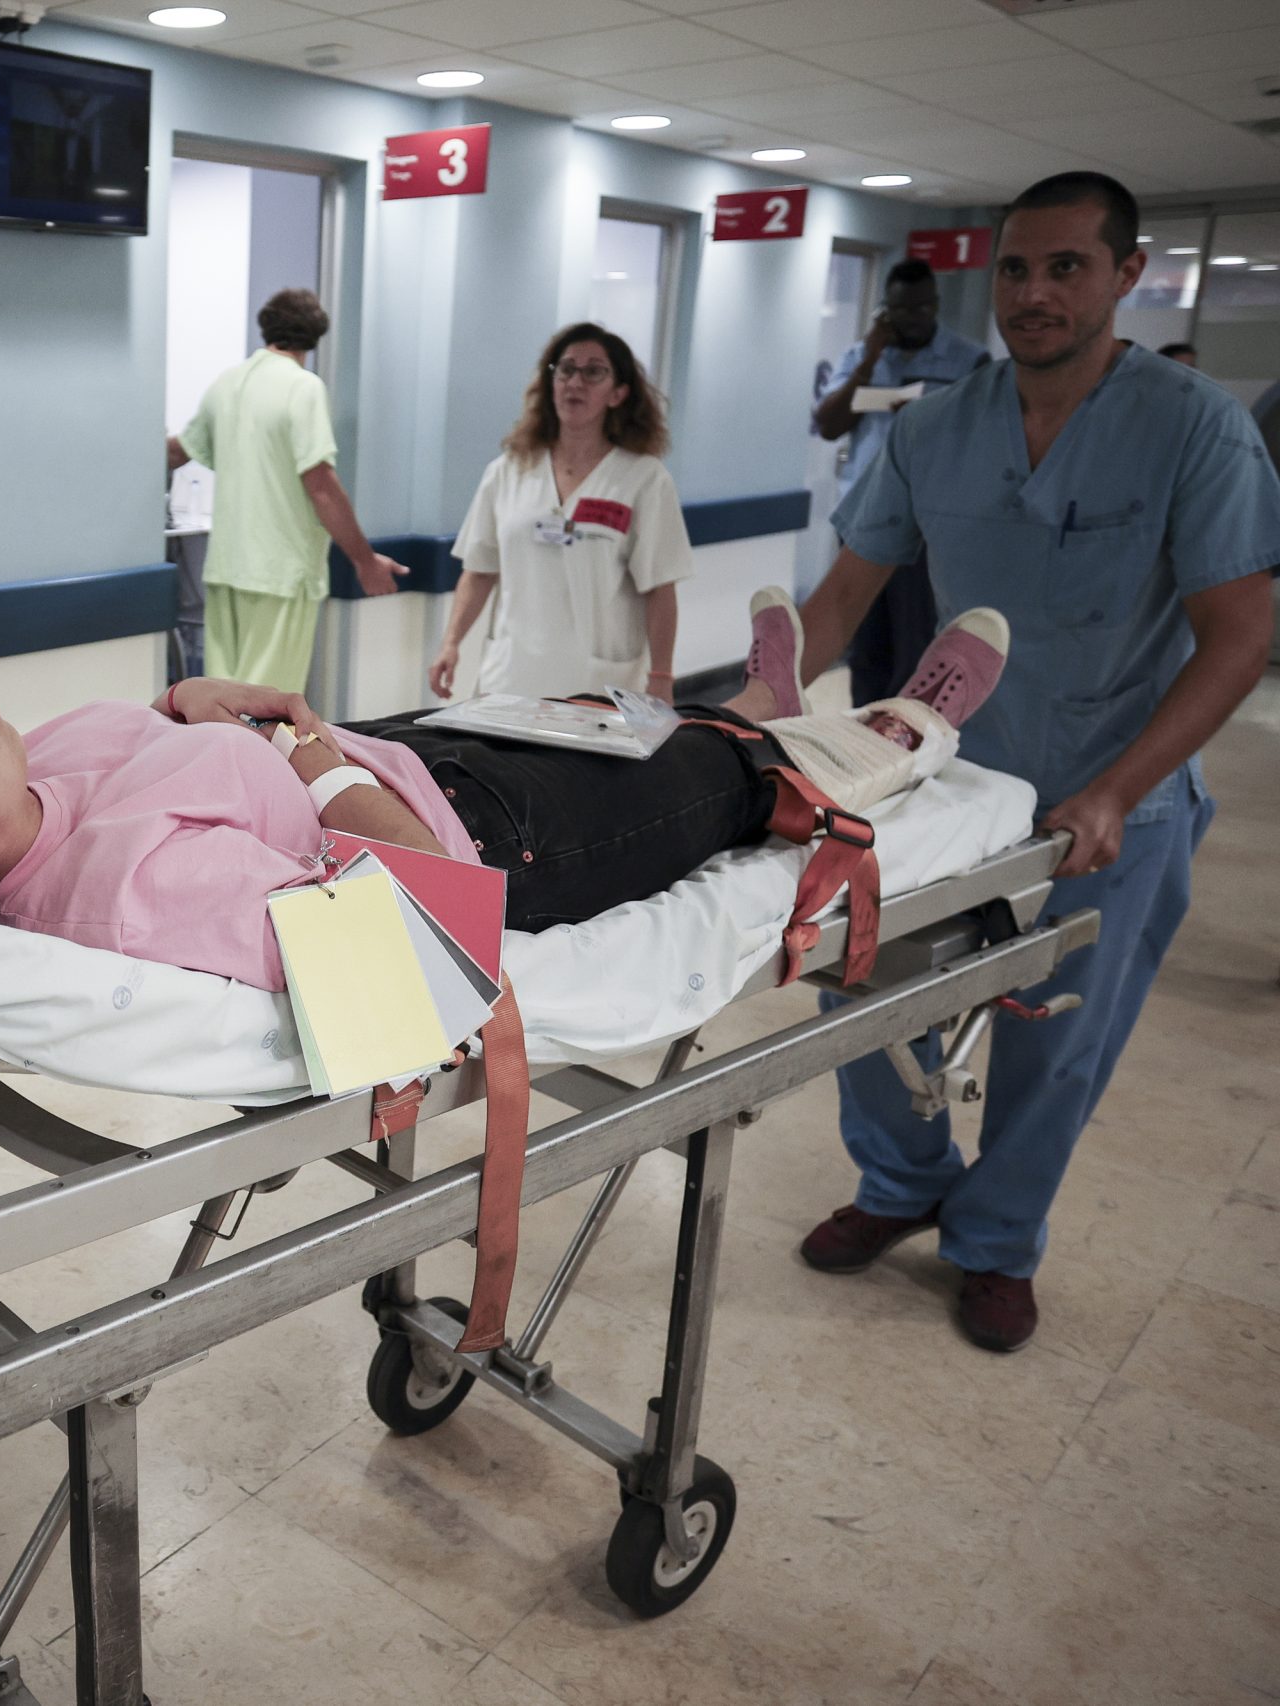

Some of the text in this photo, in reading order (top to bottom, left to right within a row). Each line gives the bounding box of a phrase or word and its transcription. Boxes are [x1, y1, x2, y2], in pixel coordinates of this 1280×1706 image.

[437, 138, 468, 187] 3
[761, 196, 790, 233] 2
[955, 234, 970, 263] 1
